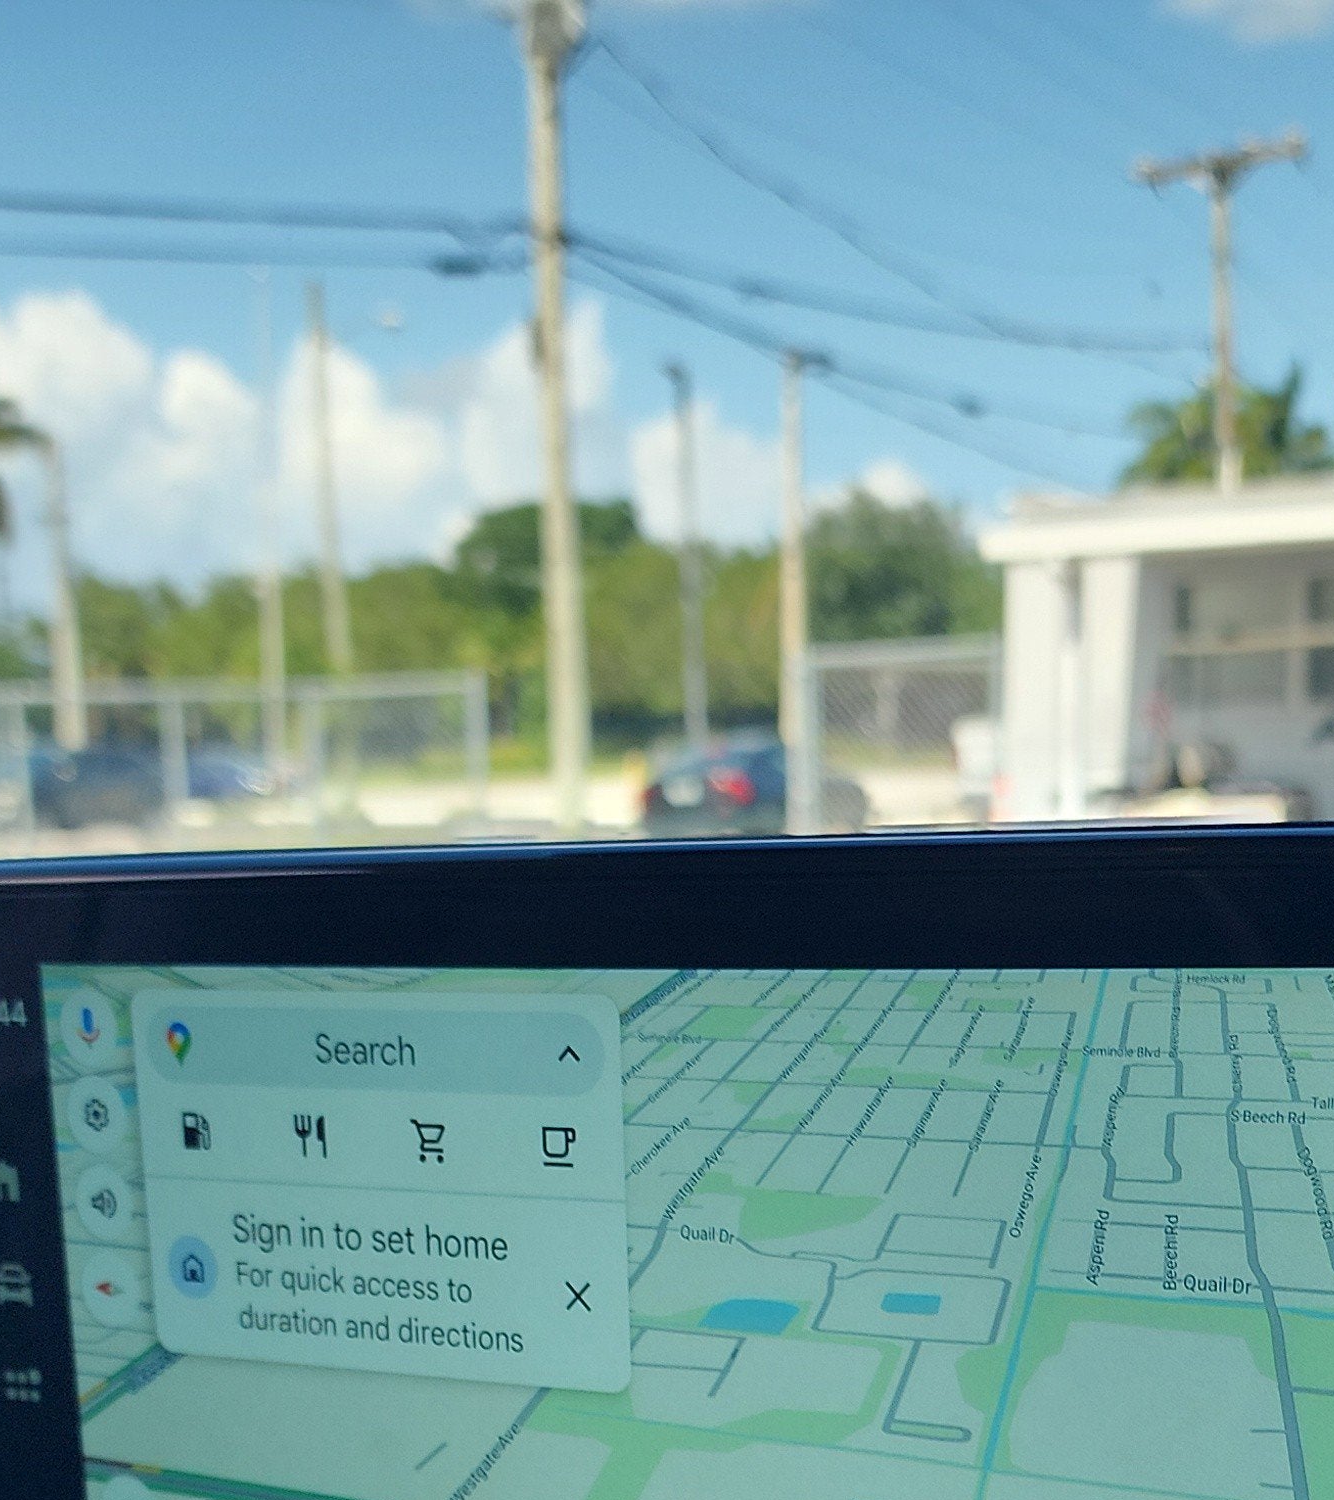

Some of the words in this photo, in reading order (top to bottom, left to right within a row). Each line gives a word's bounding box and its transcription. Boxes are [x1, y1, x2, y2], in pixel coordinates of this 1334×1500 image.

[1022, 996, 1036, 1018] Ave
[315, 1032, 416, 1067] Search
[812, 1026, 829, 1046] Ave
[1082, 1046, 1134, 1058] Seminole
[1136, 1046, 1161, 1059] Blvd
[684, 1053, 702, 1072] Ave
[827, 1066, 848, 1090] Ave
[846, 1095, 883, 1147] Hiawatha
[874, 1074, 895, 1099] Ave
[907, 1102, 937, 1149] Saginaw
[929, 1077, 949, 1104] Ave
[1111, 1085, 1128, 1107] Rd
[969, 1105, 995, 1154] Saranac
[986, 1078, 1004, 1107] Ave
[1230, 1110, 1240, 1122] S
[1242, 1111, 1285, 1124] Beech
[1288, 1112, 1306, 1125] Rd
[629, 1130, 675, 1176] Cherokee
[668, 1115, 692, 1140] Ave
[663, 1166, 706, 1222] Westgate
[701, 1144, 726, 1172] Ave
[1009, 1181, 1037, 1240] Oswego
[1023, 1152, 1042, 1183] Ave
[1297, 1146, 1330, 1218] Dogwood
[679, 1224, 716, 1244] Quail
[718, 1229, 735, 1246] Dr
[1094, 1208, 1111, 1231] Rd
[1164, 1213, 1179, 1235] Rd
[231, 1213, 292, 1254] Sign
[300, 1216, 325, 1249] in
[334, 1222, 363, 1251] to
[371, 1226, 417, 1256] set
[425, 1224, 509, 1262] home
[1086, 1232, 1107, 1287] Aspen
[1163, 1238, 1179, 1291] Beech
[235, 1260, 274, 1289] For
[280, 1265, 345, 1297] quick
[352, 1274, 440, 1302] access
[447, 1278, 473, 1304] to
[1183, 1274, 1229, 1294] Quail
[1232, 1278, 1253, 1296] Dr
[238, 1304, 338, 1337] duration
[345, 1315, 391, 1342] and
[397, 1316, 525, 1354] directions
[496, 1421, 521, 1455] Ave
